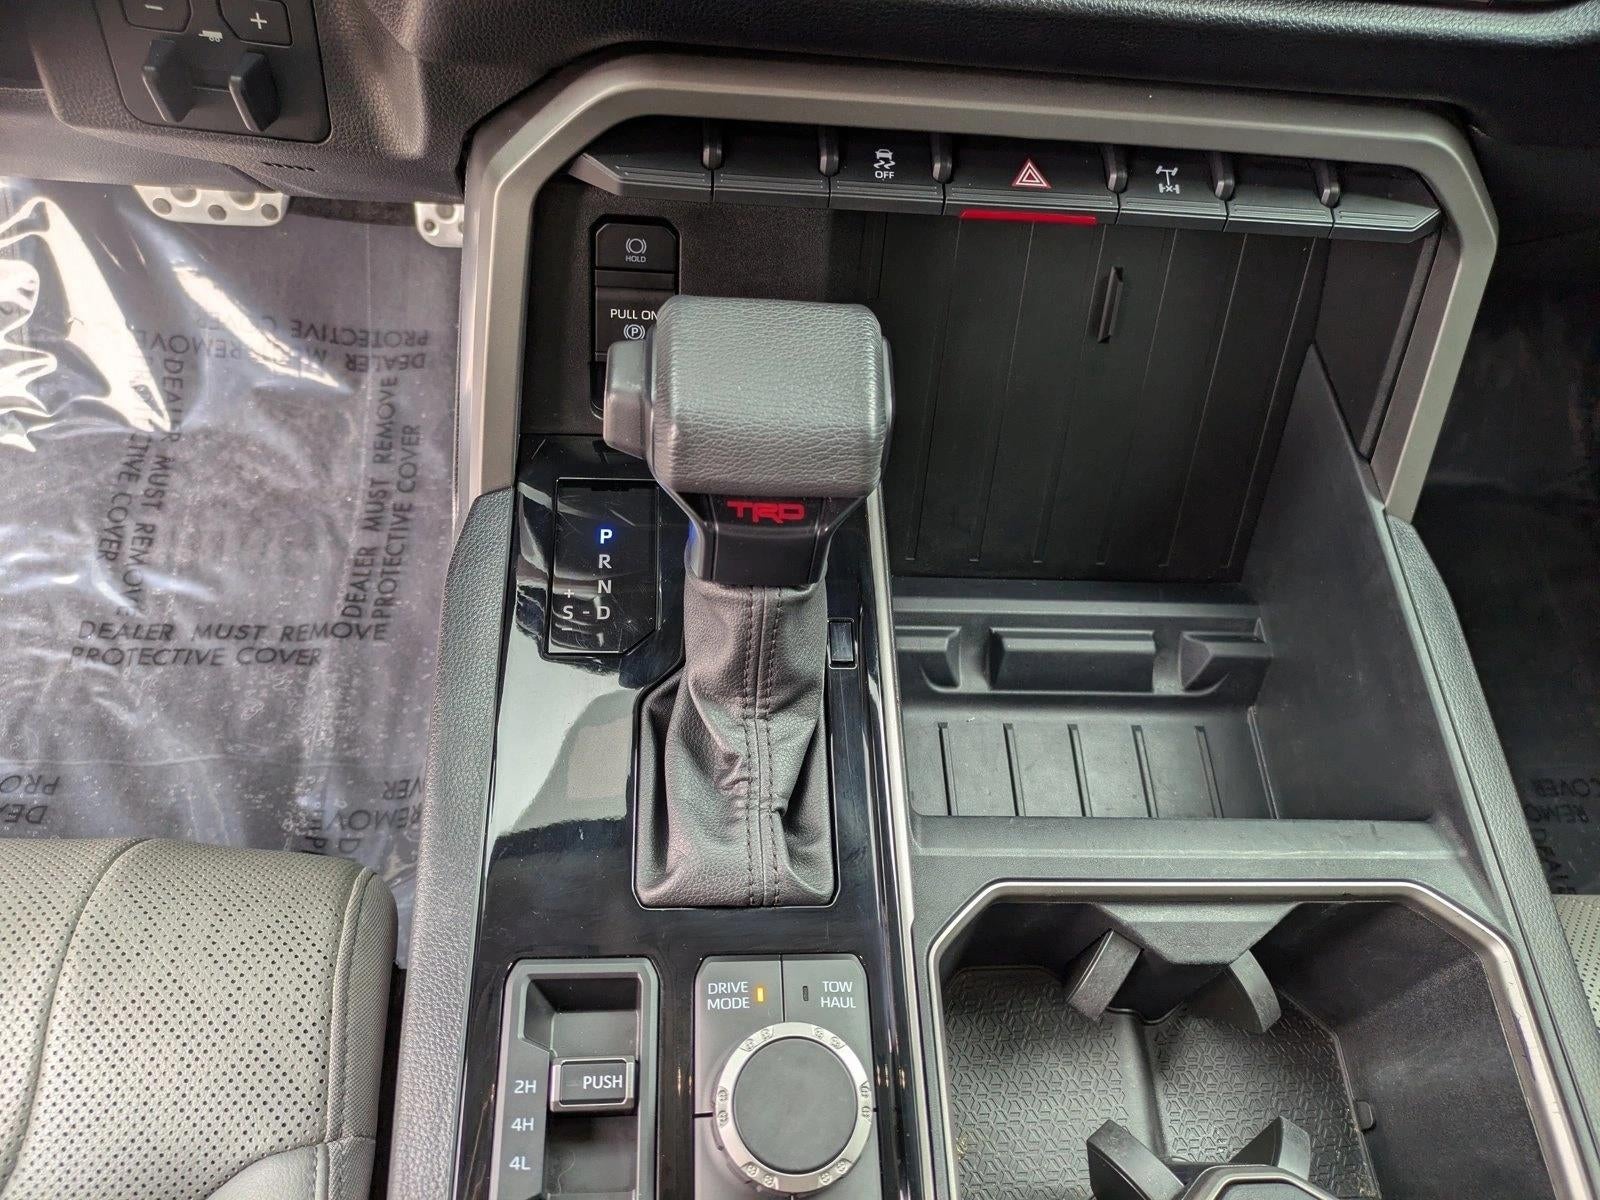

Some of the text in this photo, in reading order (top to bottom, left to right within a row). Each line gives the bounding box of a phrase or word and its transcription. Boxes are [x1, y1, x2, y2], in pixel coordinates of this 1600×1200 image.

[874, 170, 895, 179] OFF
[625, 255, 647, 263] HOLD
[610, 308, 659, 320] PULL ON
[290, 319, 429, 348] PROTECTIVE
[345, 353, 426, 373] DEALER
[141, 454, 171, 512] MUST
[341, 377, 398, 619] DEALER MUST REMOVE
[726, 500, 805, 523] TRD
[98, 492, 132, 562] COVER
[371, 425, 420, 619] PROTECTIVE COVER
[600, 528, 613, 545] P
[598, 554, 613, 569] R
[597, 580, 612, 594] N
[562, 605, 611, 620] S D
[78, 620, 389, 643] DEALER MUST REMOVE
[68, 646, 323, 667] PROTECTIVE COVER
[707, 981, 749, 995] DRIVE
[822, 981, 853, 993] TOW
[707, 997, 750, 1010] MODE
[821, 997, 856, 1009] HAUL
[514, 1080, 537, 1094] 2H
[583, 1075, 623, 1090] PUSH
[511, 1118, 535, 1131] 4H
[509, 1156, 531, 1170] 4L
